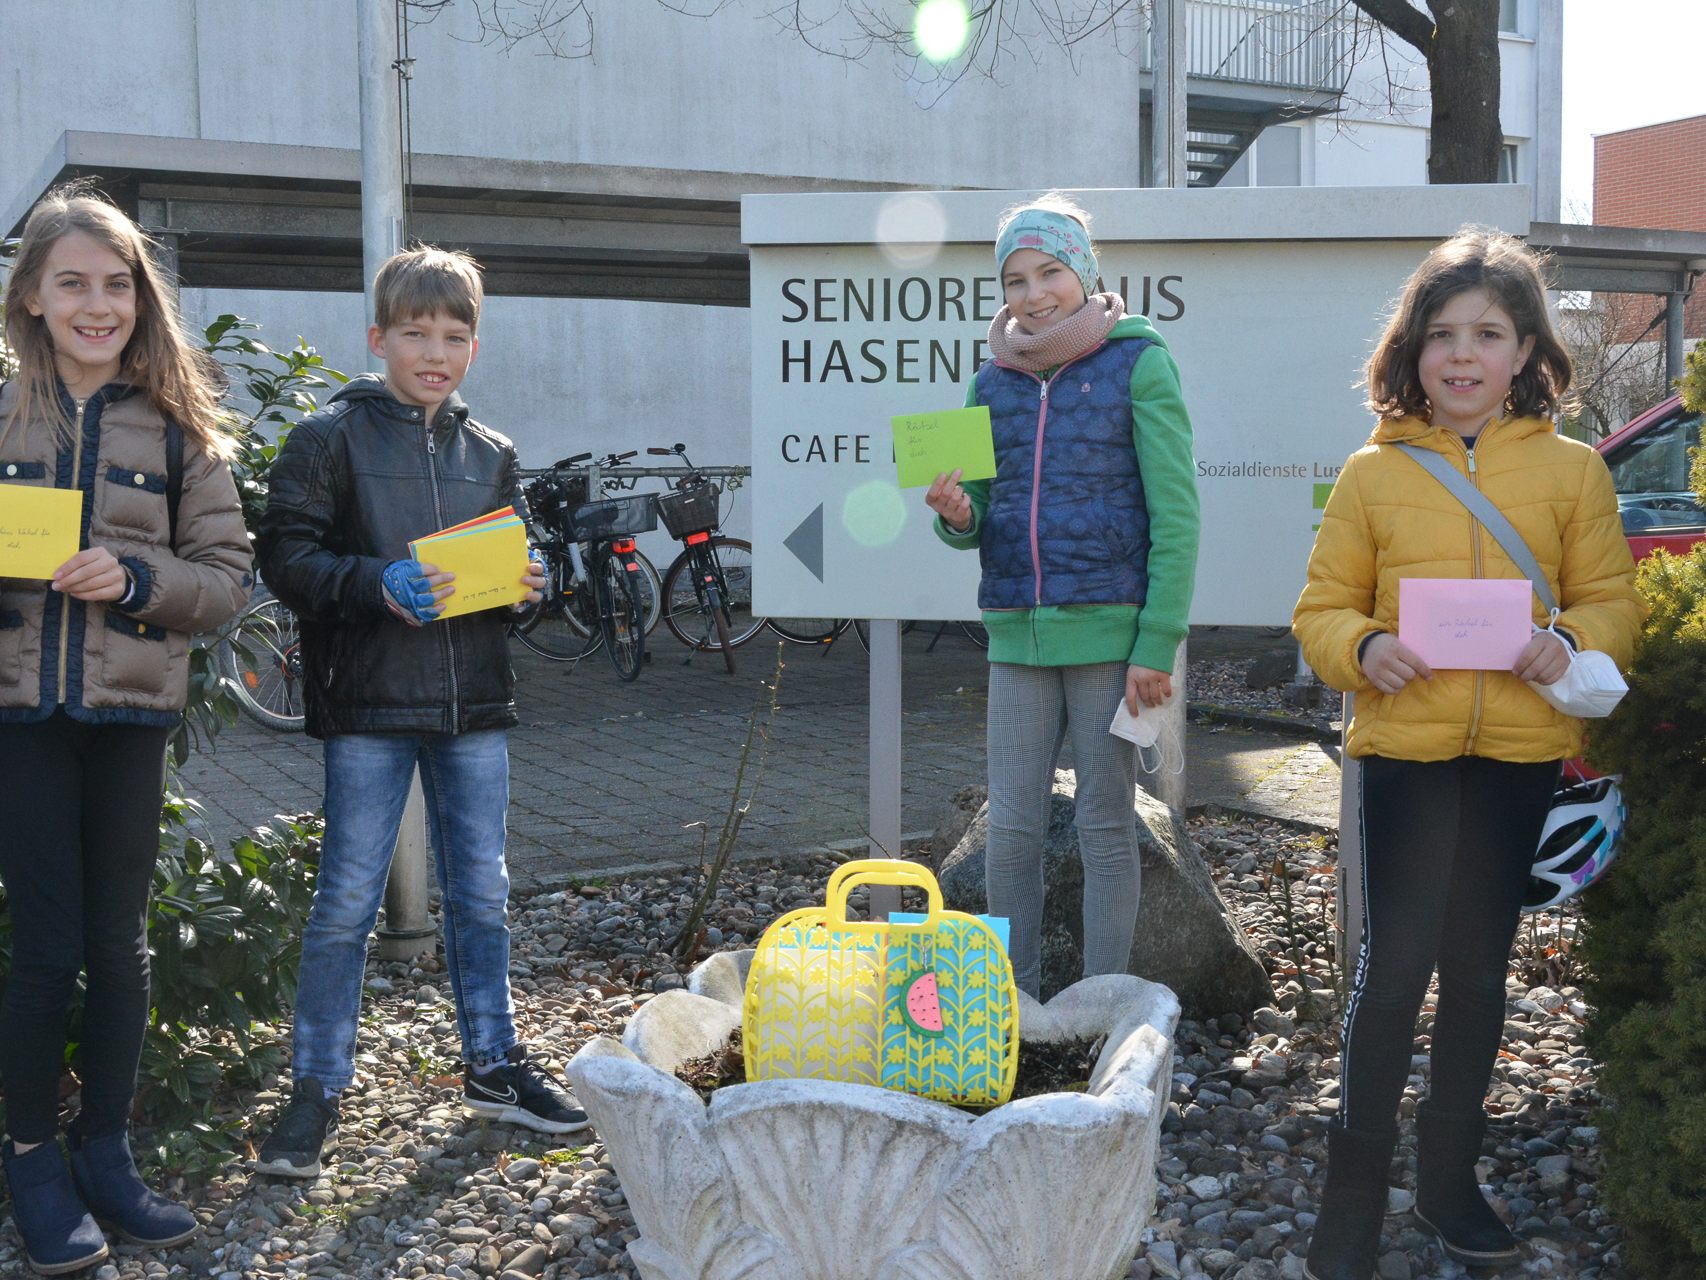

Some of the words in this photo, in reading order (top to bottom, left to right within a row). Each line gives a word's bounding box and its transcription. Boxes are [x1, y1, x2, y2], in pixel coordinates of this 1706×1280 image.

[781, 275, 1185, 322] SENIOREUS
[781, 434, 870, 463] CAFE
[1197, 461, 1307, 478] Sozialdienste
[1313, 462, 1344, 478] Lus
